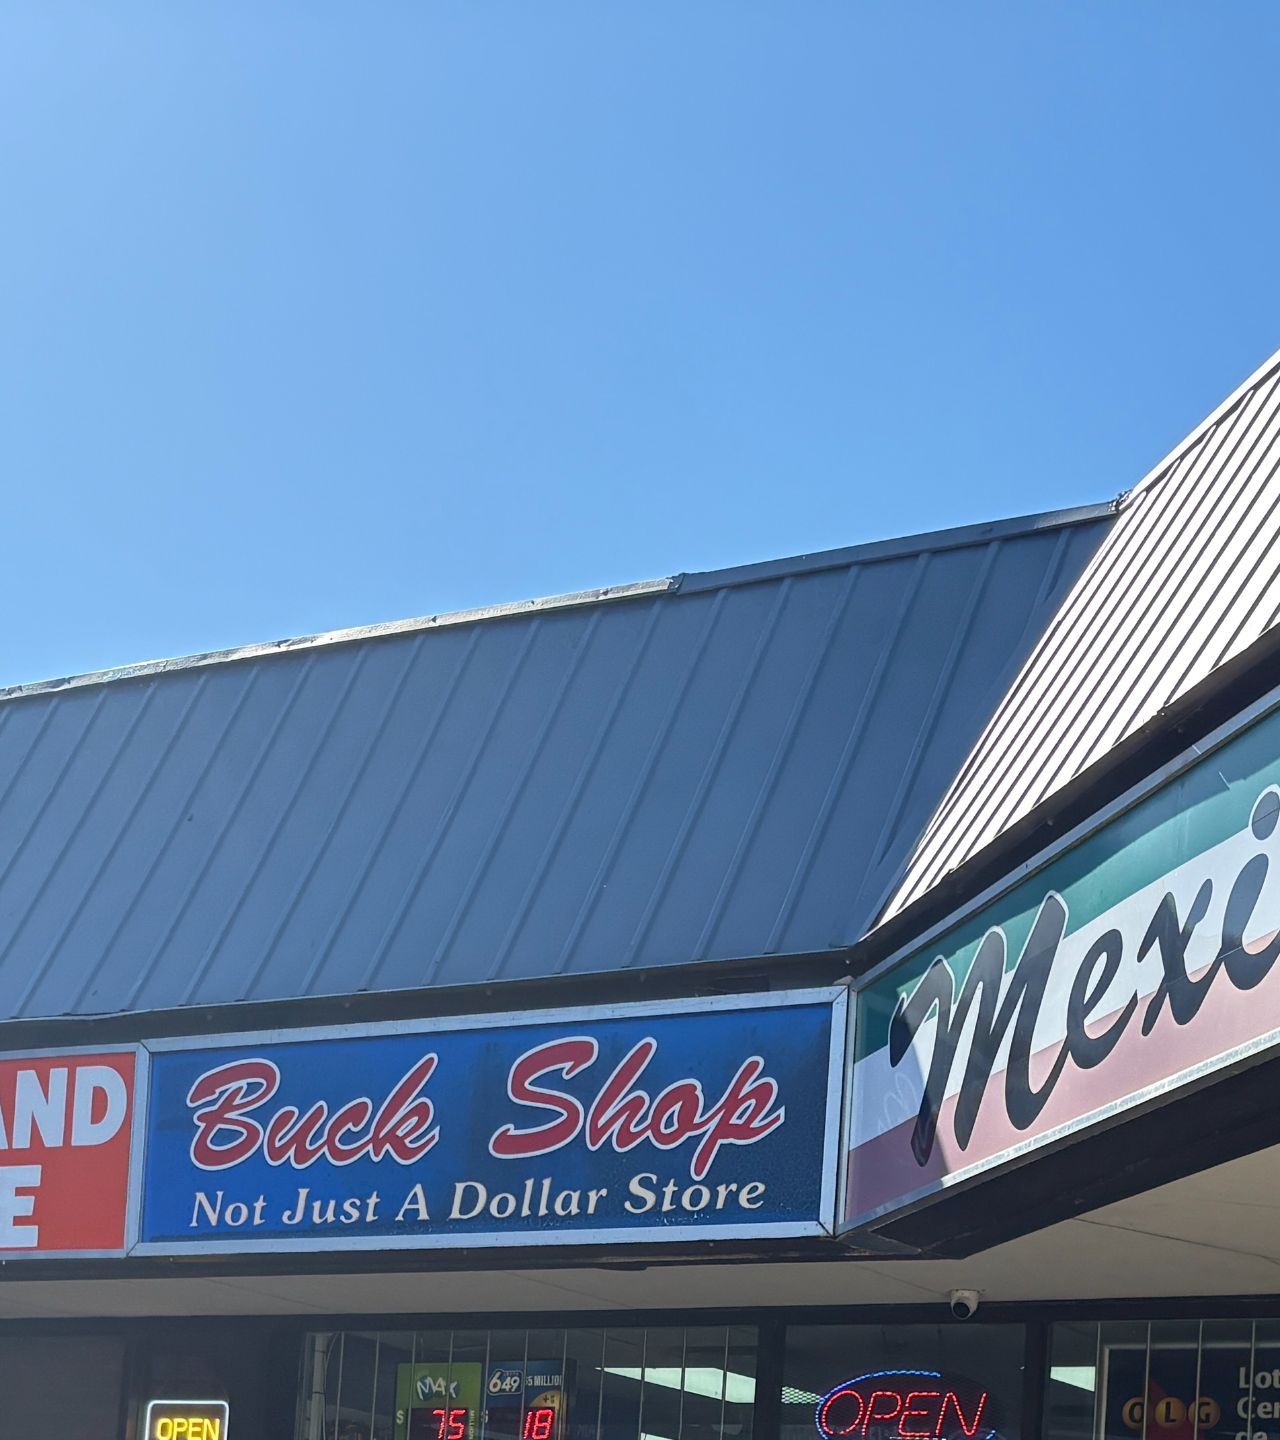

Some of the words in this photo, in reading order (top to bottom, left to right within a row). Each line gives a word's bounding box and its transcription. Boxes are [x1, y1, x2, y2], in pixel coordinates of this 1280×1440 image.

[186, 1052, 440, 1171] Buck
[489, 1035, 785, 1181] Shop
[190, 1190, 266, 1228] Not
[282, 1186, 379, 1226] Just
[395, 1182, 431, 1222] A
[449, 1177, 608, 1221] Dollar
[623, 1172, 766, 1215] Store
[433, 1409, 468, 1440] 75
[523, 1408, 554, 1440] 18
[821, 1390, 987, 1438] OPEN
[1131, 1400, 1214, 1425] OLG
